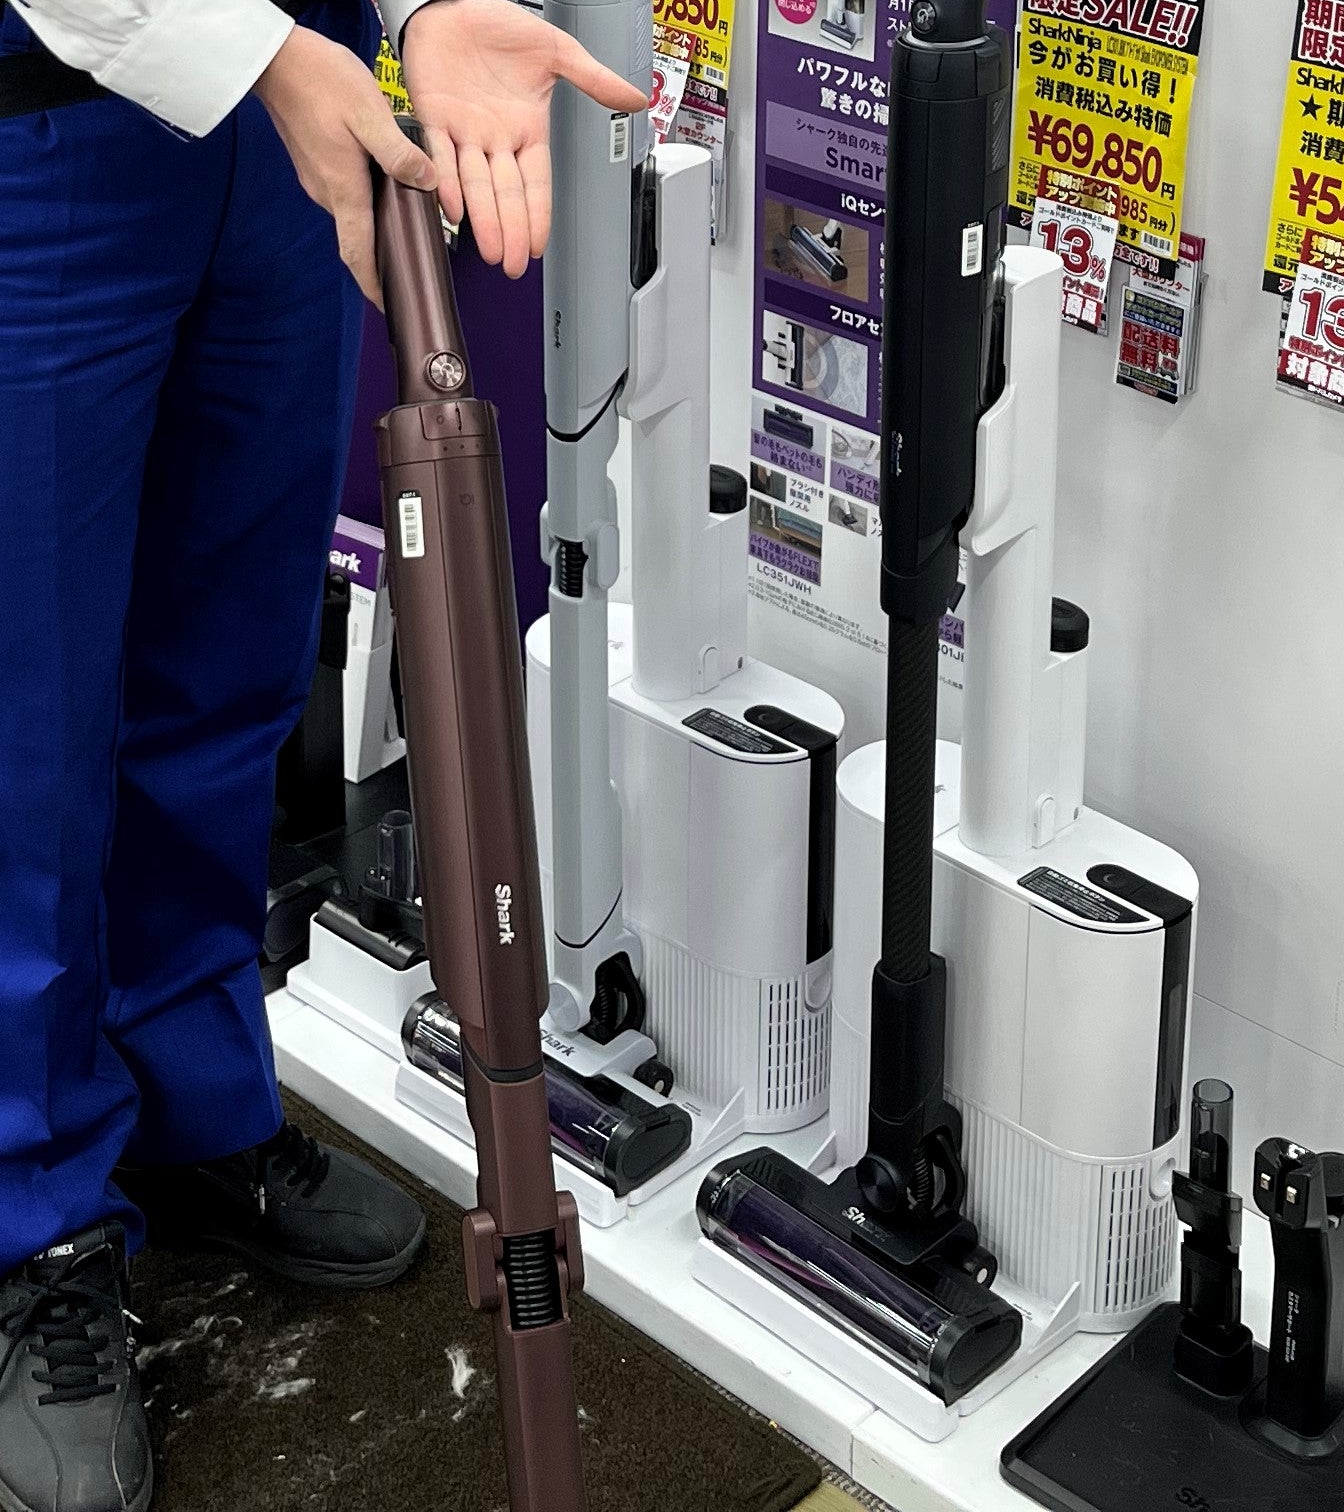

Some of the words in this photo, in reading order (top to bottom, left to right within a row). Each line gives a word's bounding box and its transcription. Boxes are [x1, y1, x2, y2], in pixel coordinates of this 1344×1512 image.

[1027, 17, 1103, 54] SharkNinja
[1026, 39, 1179, 106] 今がお買い得!
[1034, 74, 1173, 137] 消費税込み特価
[755, 561, 812, 596] LC351JWH
[495, 882, 516, 947] Shark
